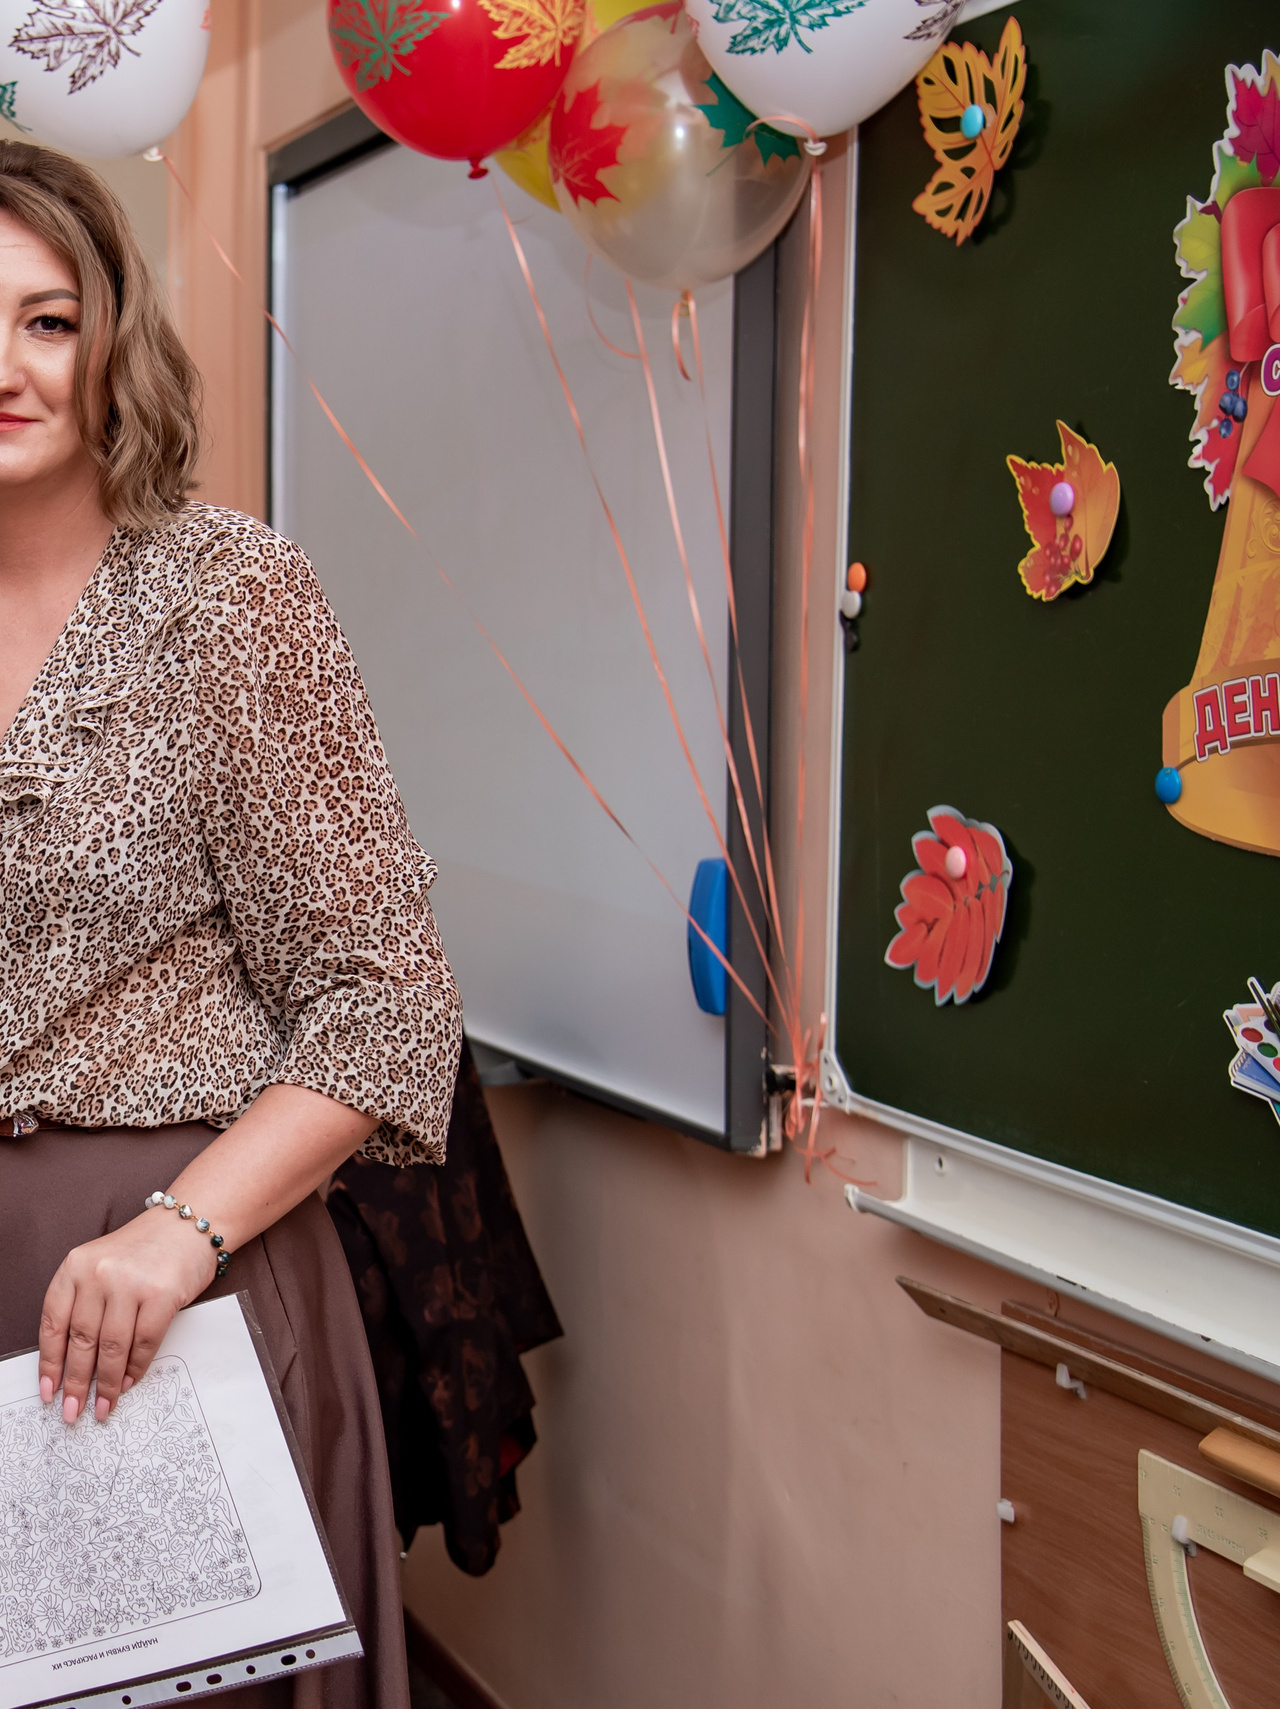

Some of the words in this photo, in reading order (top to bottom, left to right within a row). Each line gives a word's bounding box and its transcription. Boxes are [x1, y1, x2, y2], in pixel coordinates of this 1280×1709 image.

[132, 1637, 159, 1651] НАЙДИ
[99, 1651, 105, 1659] И
[106, 1645, 131, 1657] БУКВЫ
[63, 1653, 98, 1667] РАСКРАСЬ
[52, 1662, 63, 1671] ИХ
